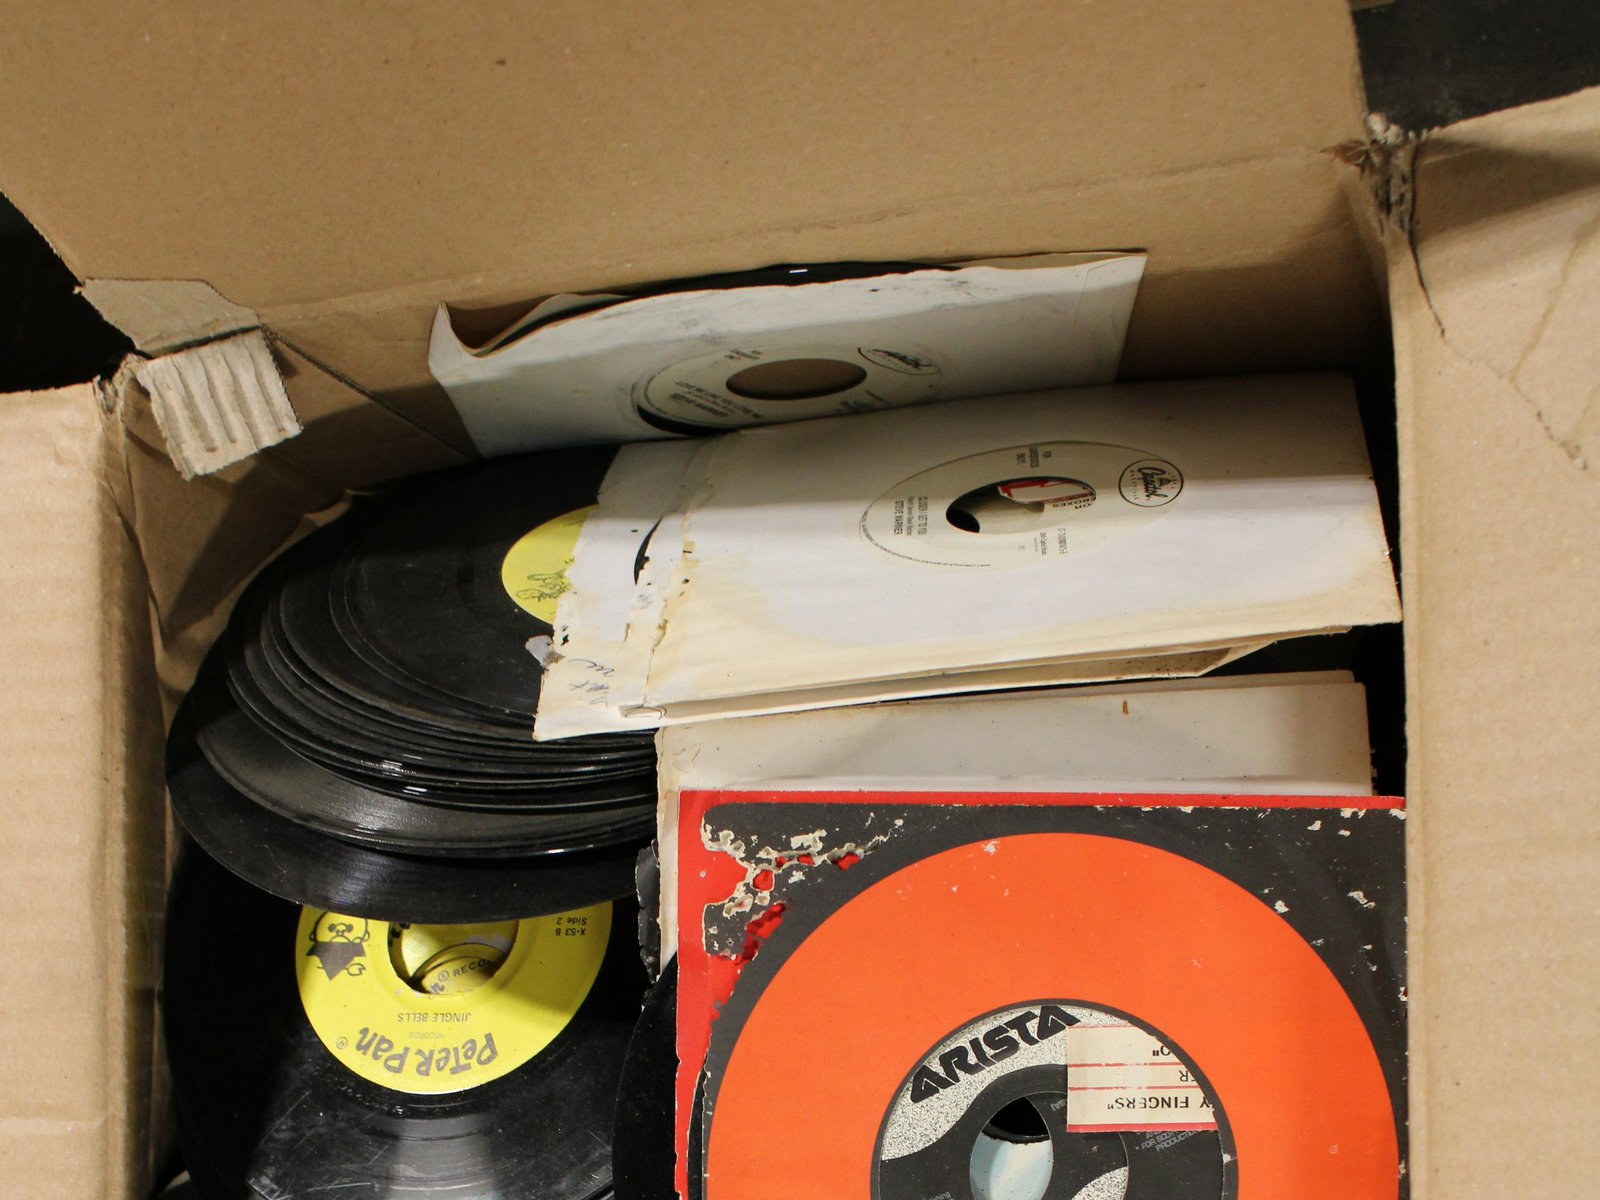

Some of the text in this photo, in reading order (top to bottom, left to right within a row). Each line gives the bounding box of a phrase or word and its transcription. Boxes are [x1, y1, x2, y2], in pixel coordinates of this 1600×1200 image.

[566, 917, 586, 926] Side
[565, 928, 586, 936] X-53
[453, 958, 487, 976] RECO
[398, 1012, 472, 1022] JINGLE BELLS
[910, 1005, 1081, 1104] ARISTA
